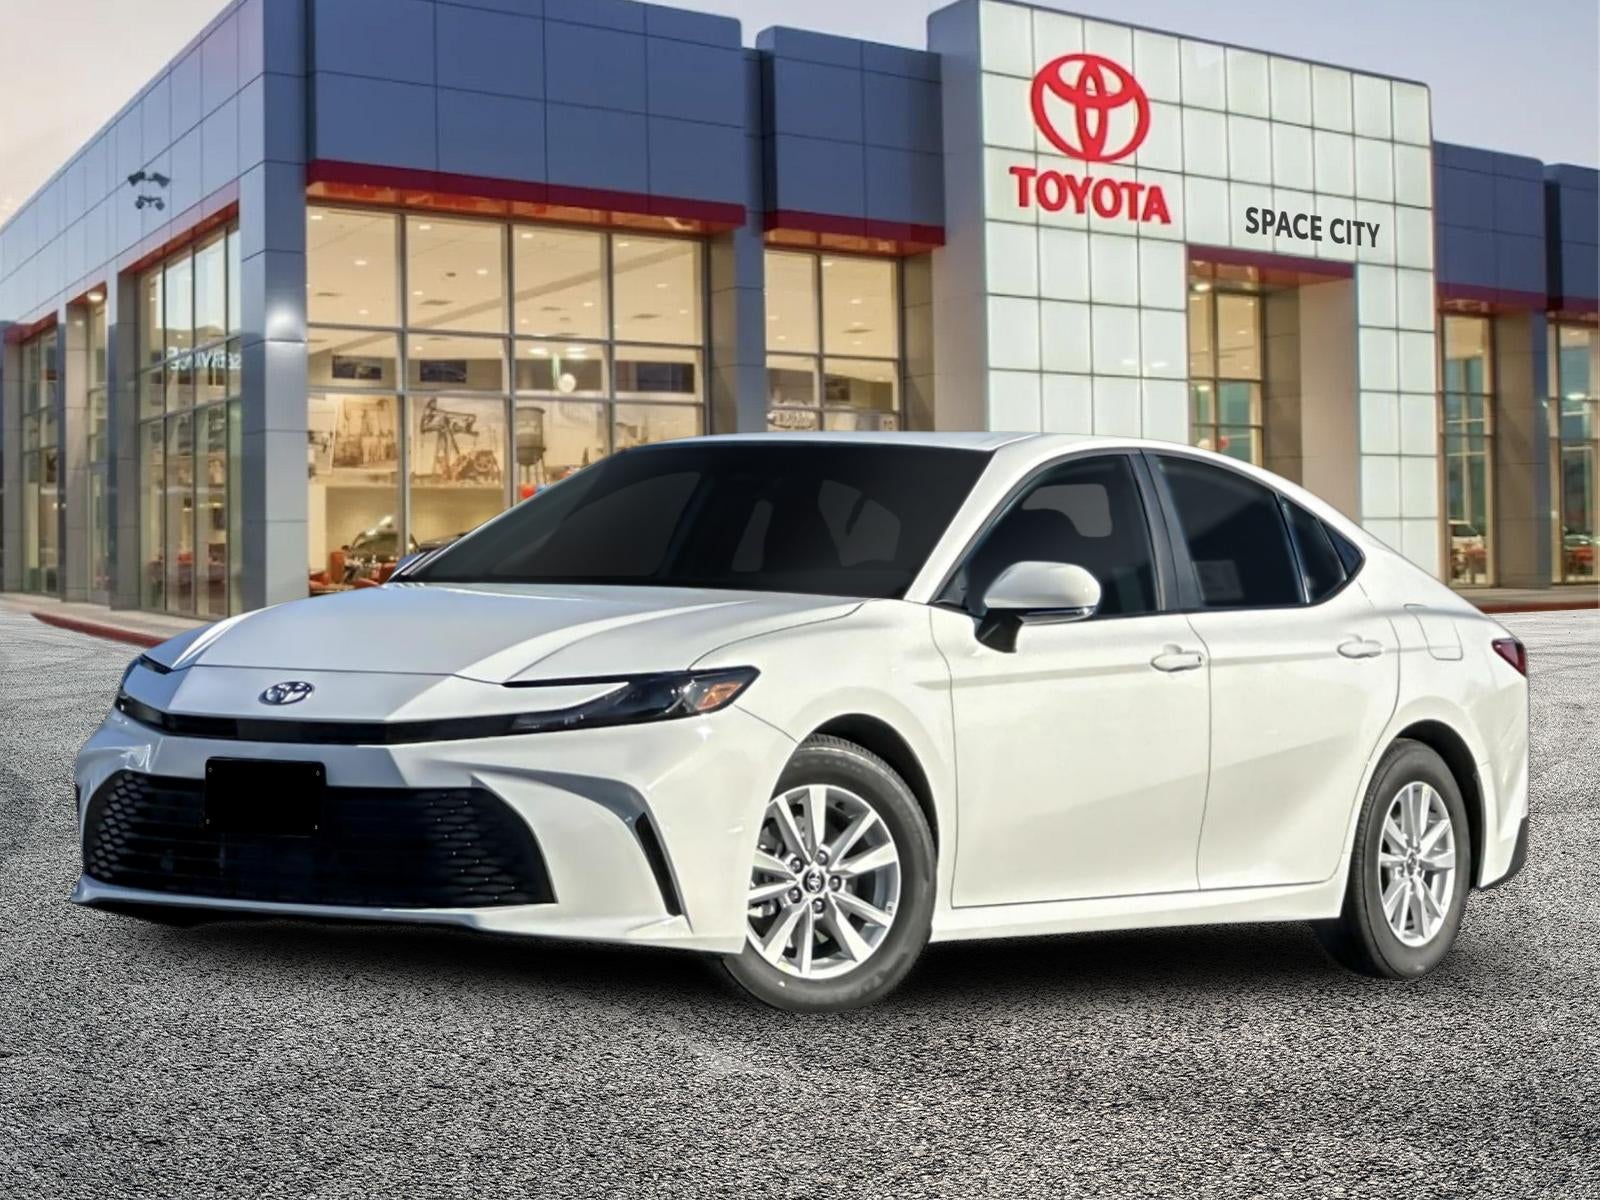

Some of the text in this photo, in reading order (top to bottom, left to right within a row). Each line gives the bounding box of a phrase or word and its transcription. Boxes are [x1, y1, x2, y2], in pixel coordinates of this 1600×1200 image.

[1009, 165, 1171, 225] TOYOTA
[1245, 206, 1381, 248] SPACE CITY
